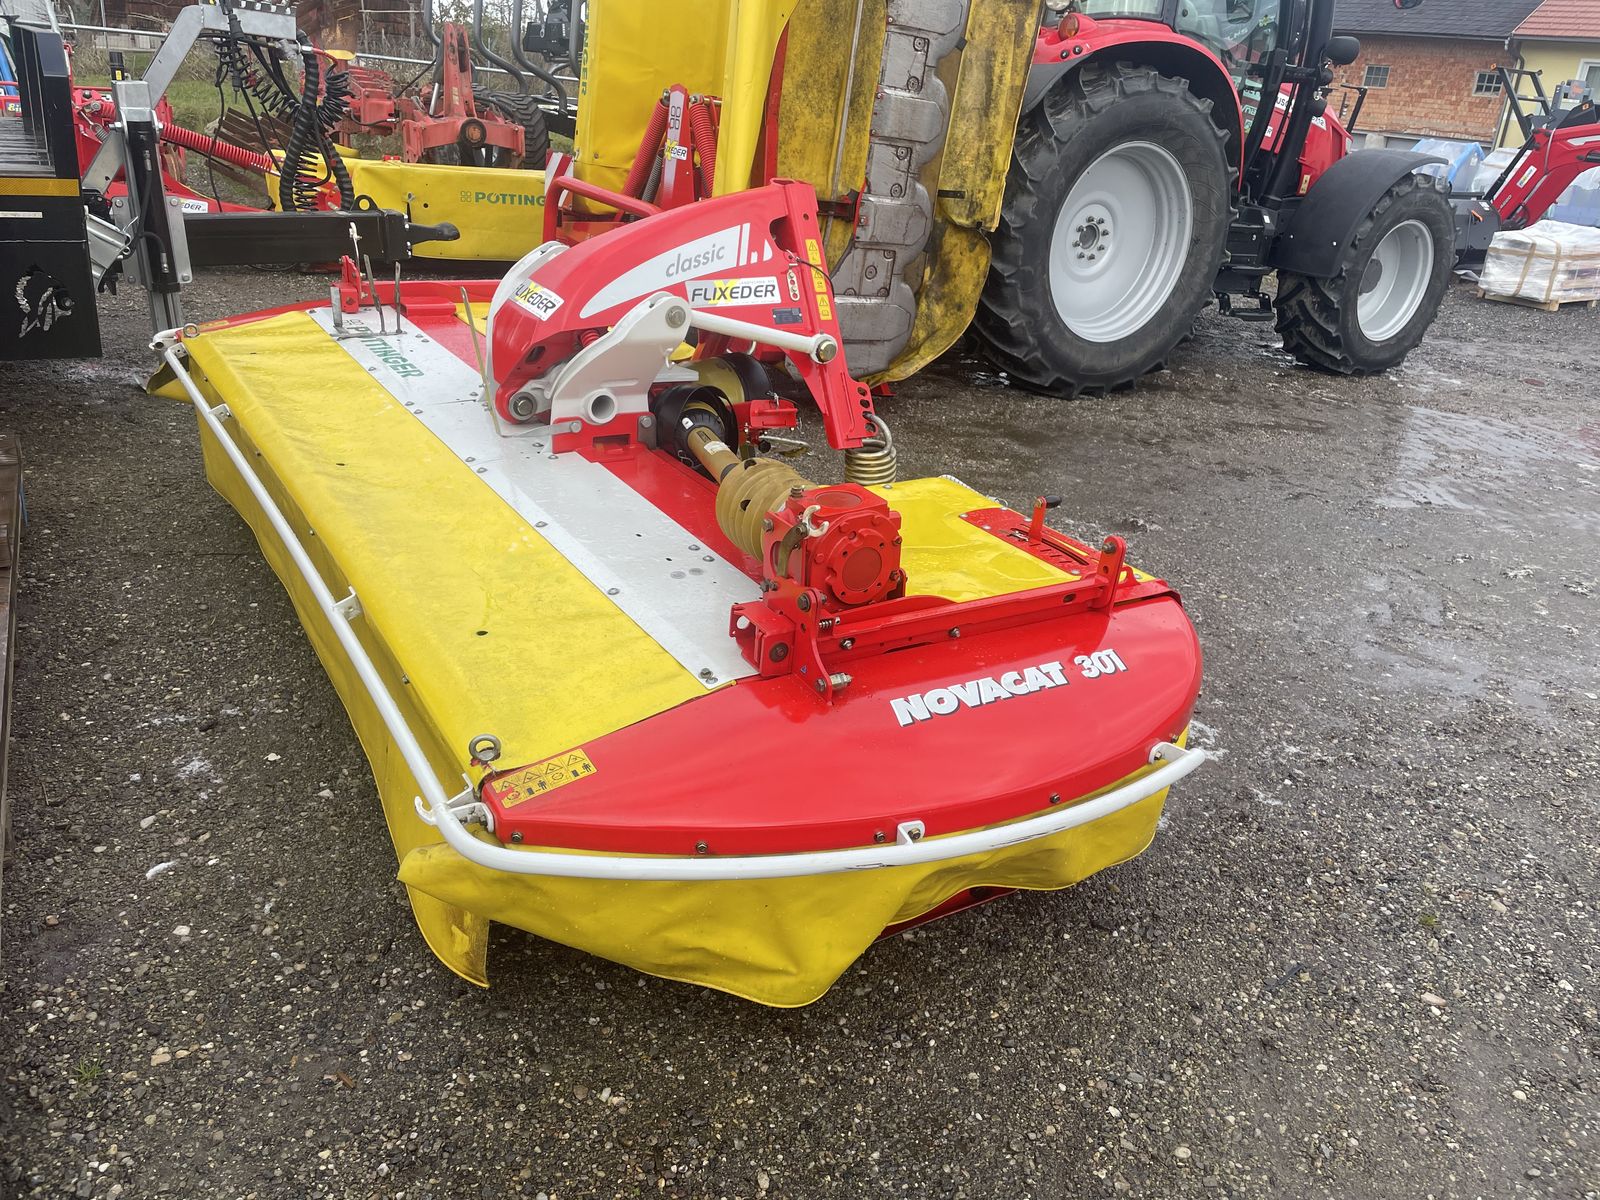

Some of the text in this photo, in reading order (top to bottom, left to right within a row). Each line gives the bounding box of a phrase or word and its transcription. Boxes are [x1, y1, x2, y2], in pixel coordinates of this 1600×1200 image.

[665, 243, 725, 278] classic
[691, 284, 776, 302] FLIXEDER
[346, 326, 425, 378] PTTINGER
[889, 648, 1128, 727] NOVACAT 301
